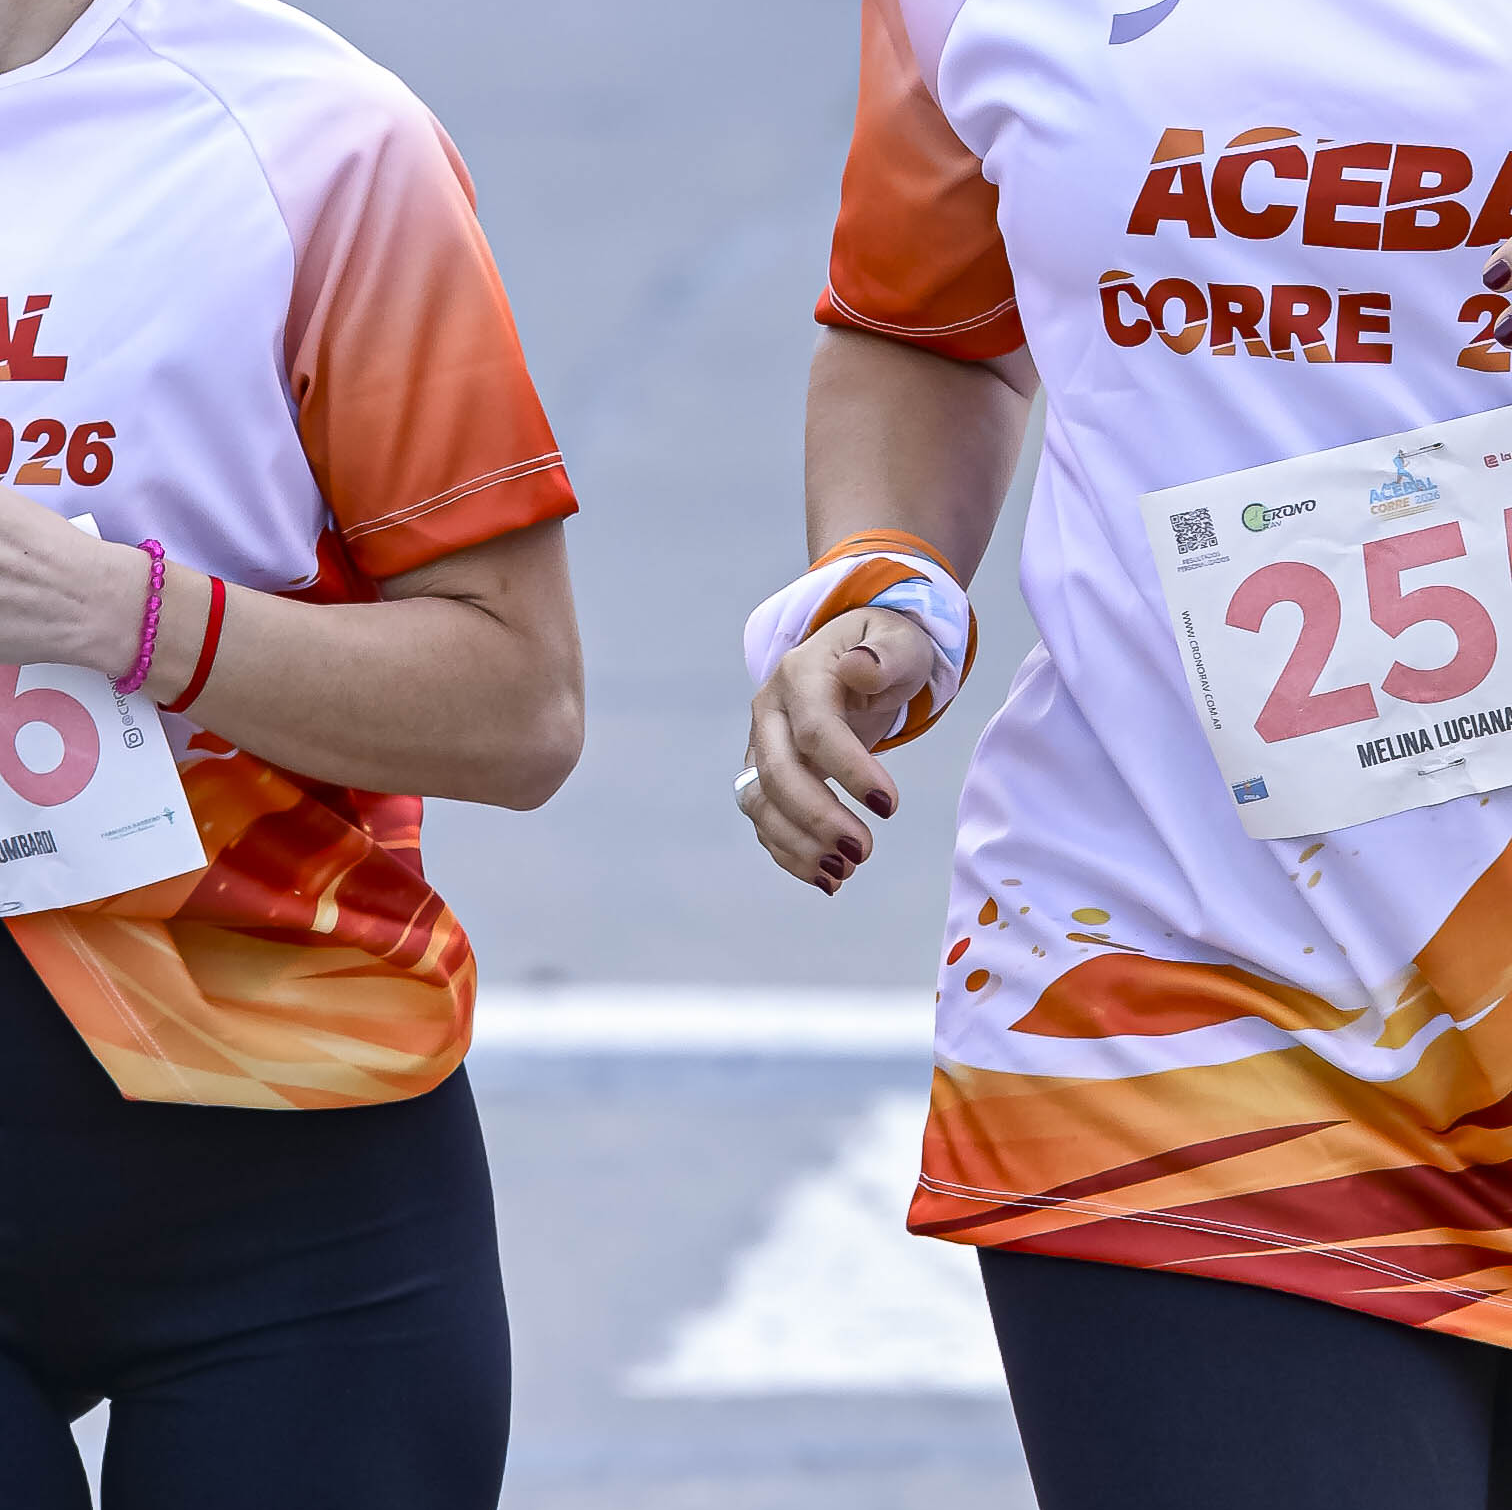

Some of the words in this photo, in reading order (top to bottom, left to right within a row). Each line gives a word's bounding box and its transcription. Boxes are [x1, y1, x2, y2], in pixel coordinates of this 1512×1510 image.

[0, 293, 69, 382] L
[1097, 268, 1393, 365] CORRE
[1370, 497, 1410, 515] CORRE
[1181, 610, 1222, 730] WWW.CRONORAV.COM.AR
[1356, 728, 1435, 769] MELINA
